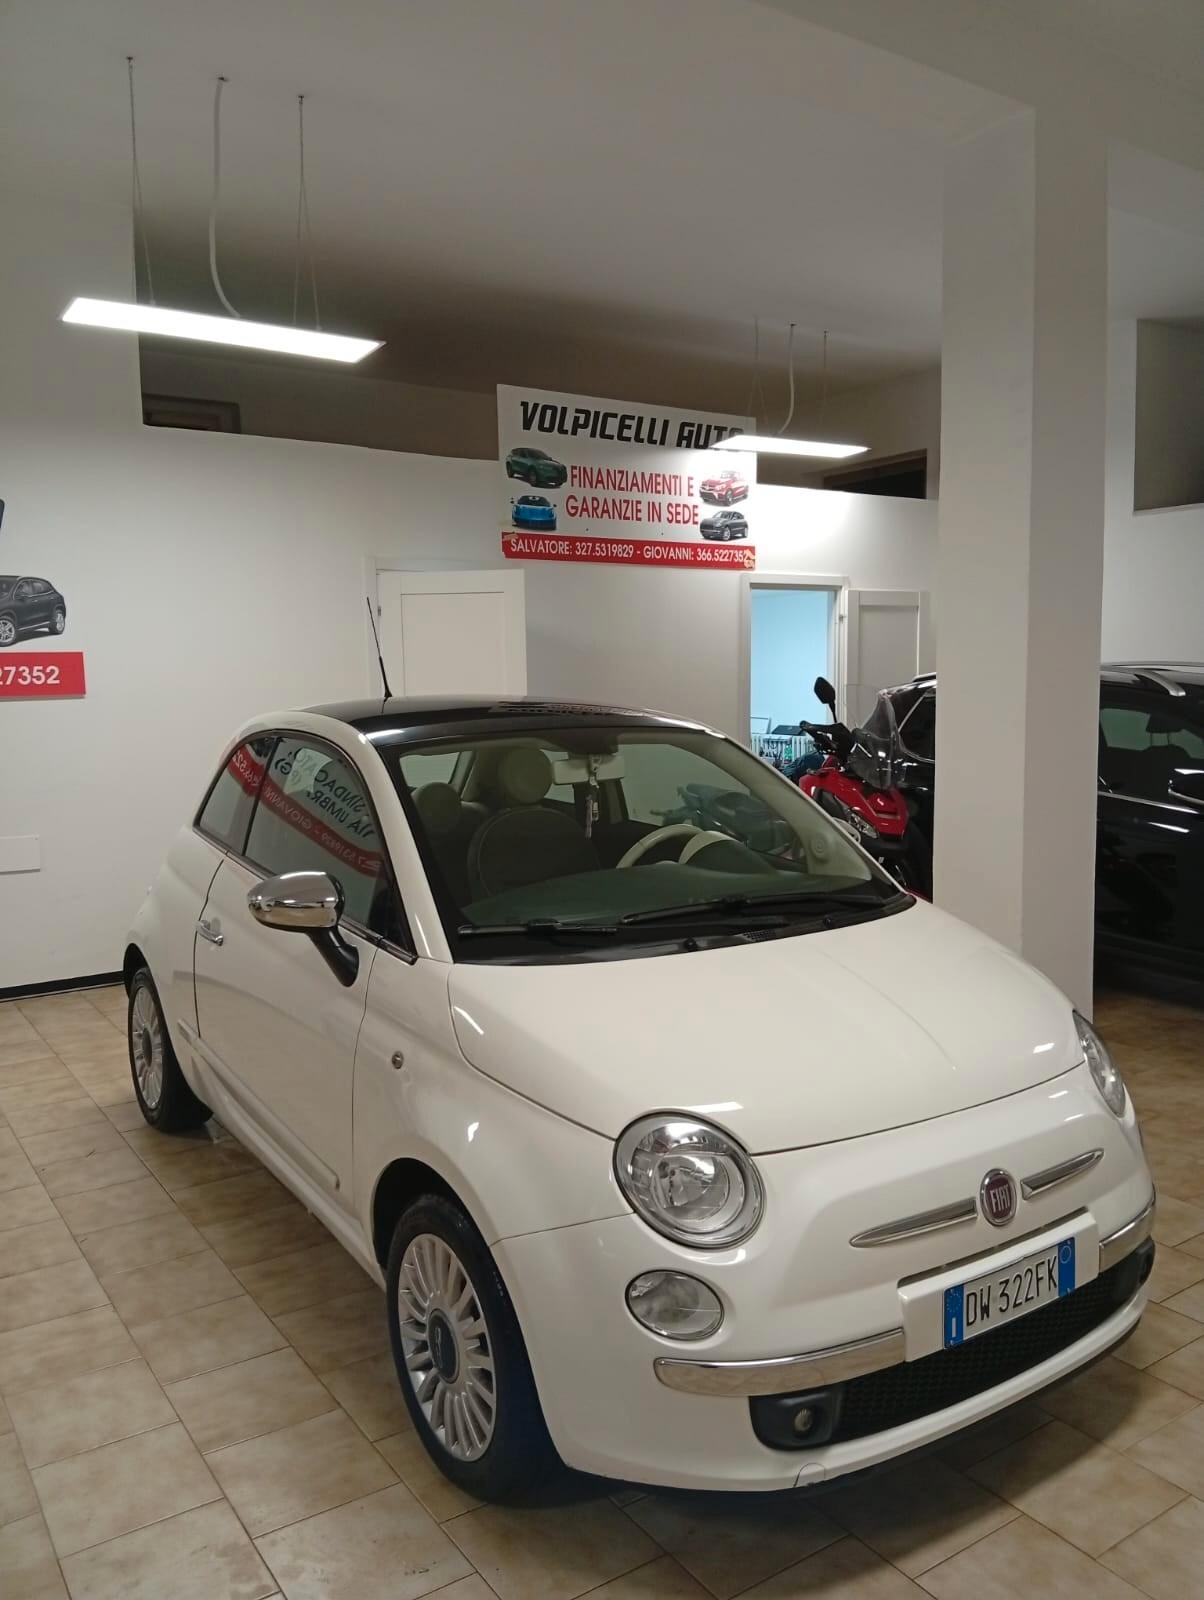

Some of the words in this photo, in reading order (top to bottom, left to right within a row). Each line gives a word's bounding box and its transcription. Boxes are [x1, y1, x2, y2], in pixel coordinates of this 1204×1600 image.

[520, 401, 669, 446] VOLPICELLI
[571, 465, 682, 496] FINANZIAMENTI
[688, 476, 694, 496] E
[566, 495, 642, 521] GARANZIE
[648, 501, 661, 522] IN
[667, 502, 699, 525] SEDE
[511, 539, 573, 555] SALVATORE:
[575, 542, 634, 558] 327.5319829
[643, 545, 694, 560] GIOVANNI:
[0, 666, 60, 685] 7352
[990, 1184, 1010, 1212] FIAT
[966, 1285, 991, 1326] DW
[999, 1256, 1058, 1312] 322FK
